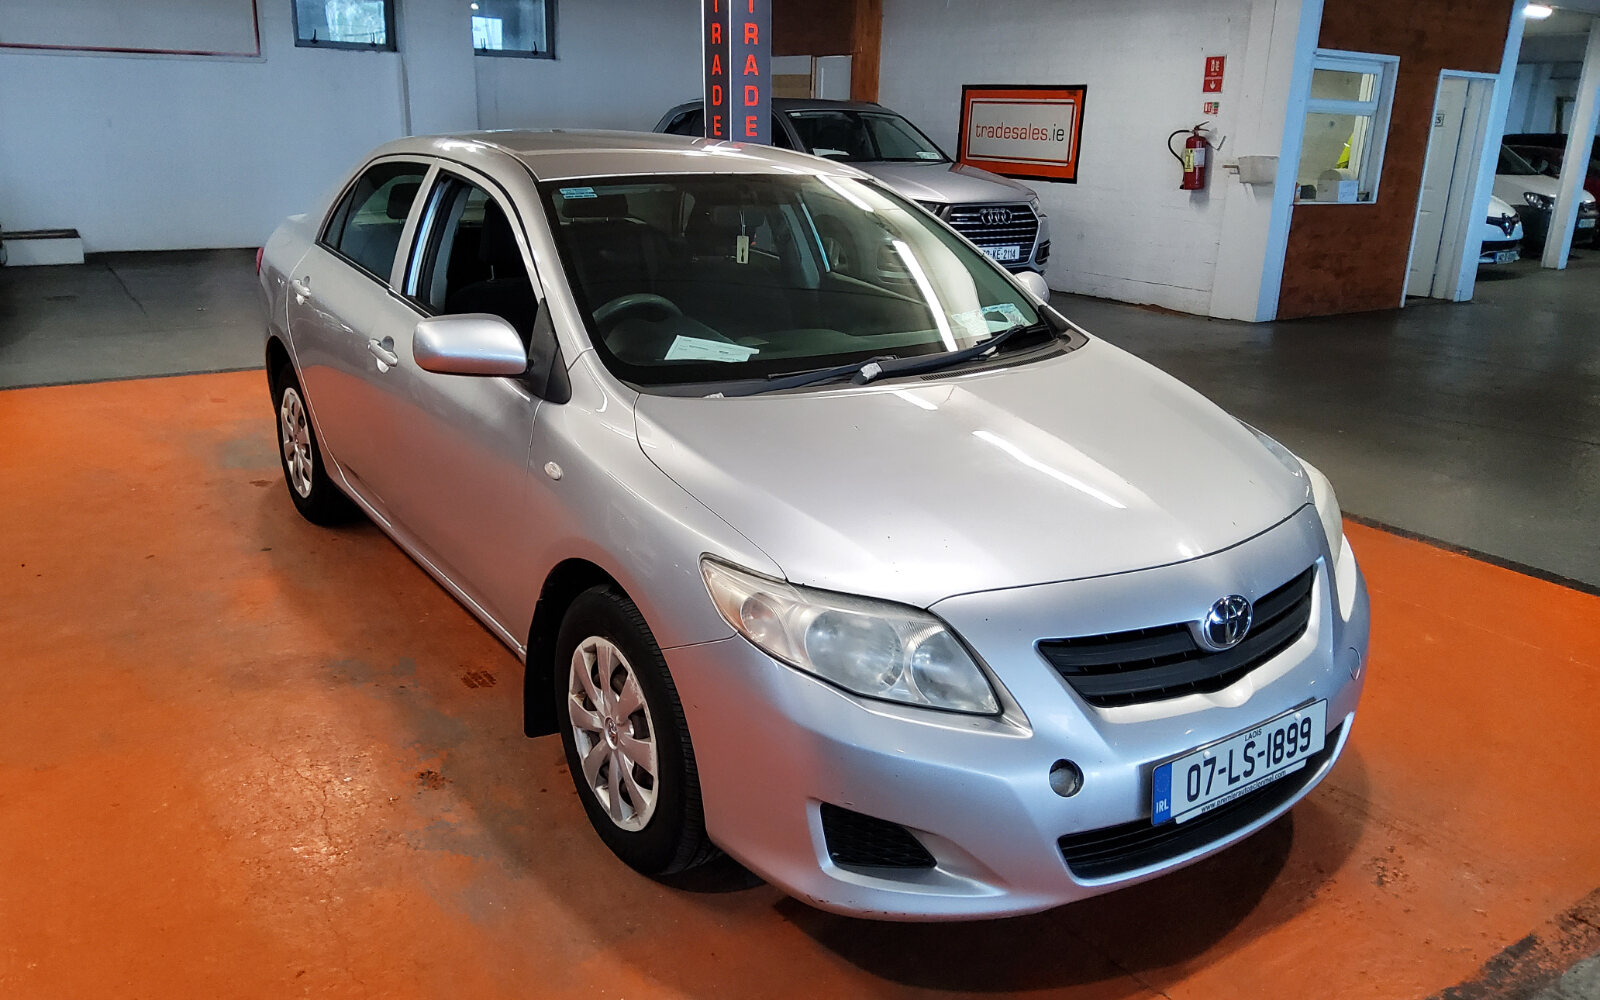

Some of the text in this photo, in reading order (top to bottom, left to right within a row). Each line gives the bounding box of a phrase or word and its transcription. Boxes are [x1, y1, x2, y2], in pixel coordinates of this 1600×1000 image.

[975, 122, 1065, 142] tradesales.ie
[1244, 729, 1262, 742] LAOIS
[1187, 717, 1312, 803] 07-LS-1899
[1155, 802, 1169, 814] IRL
